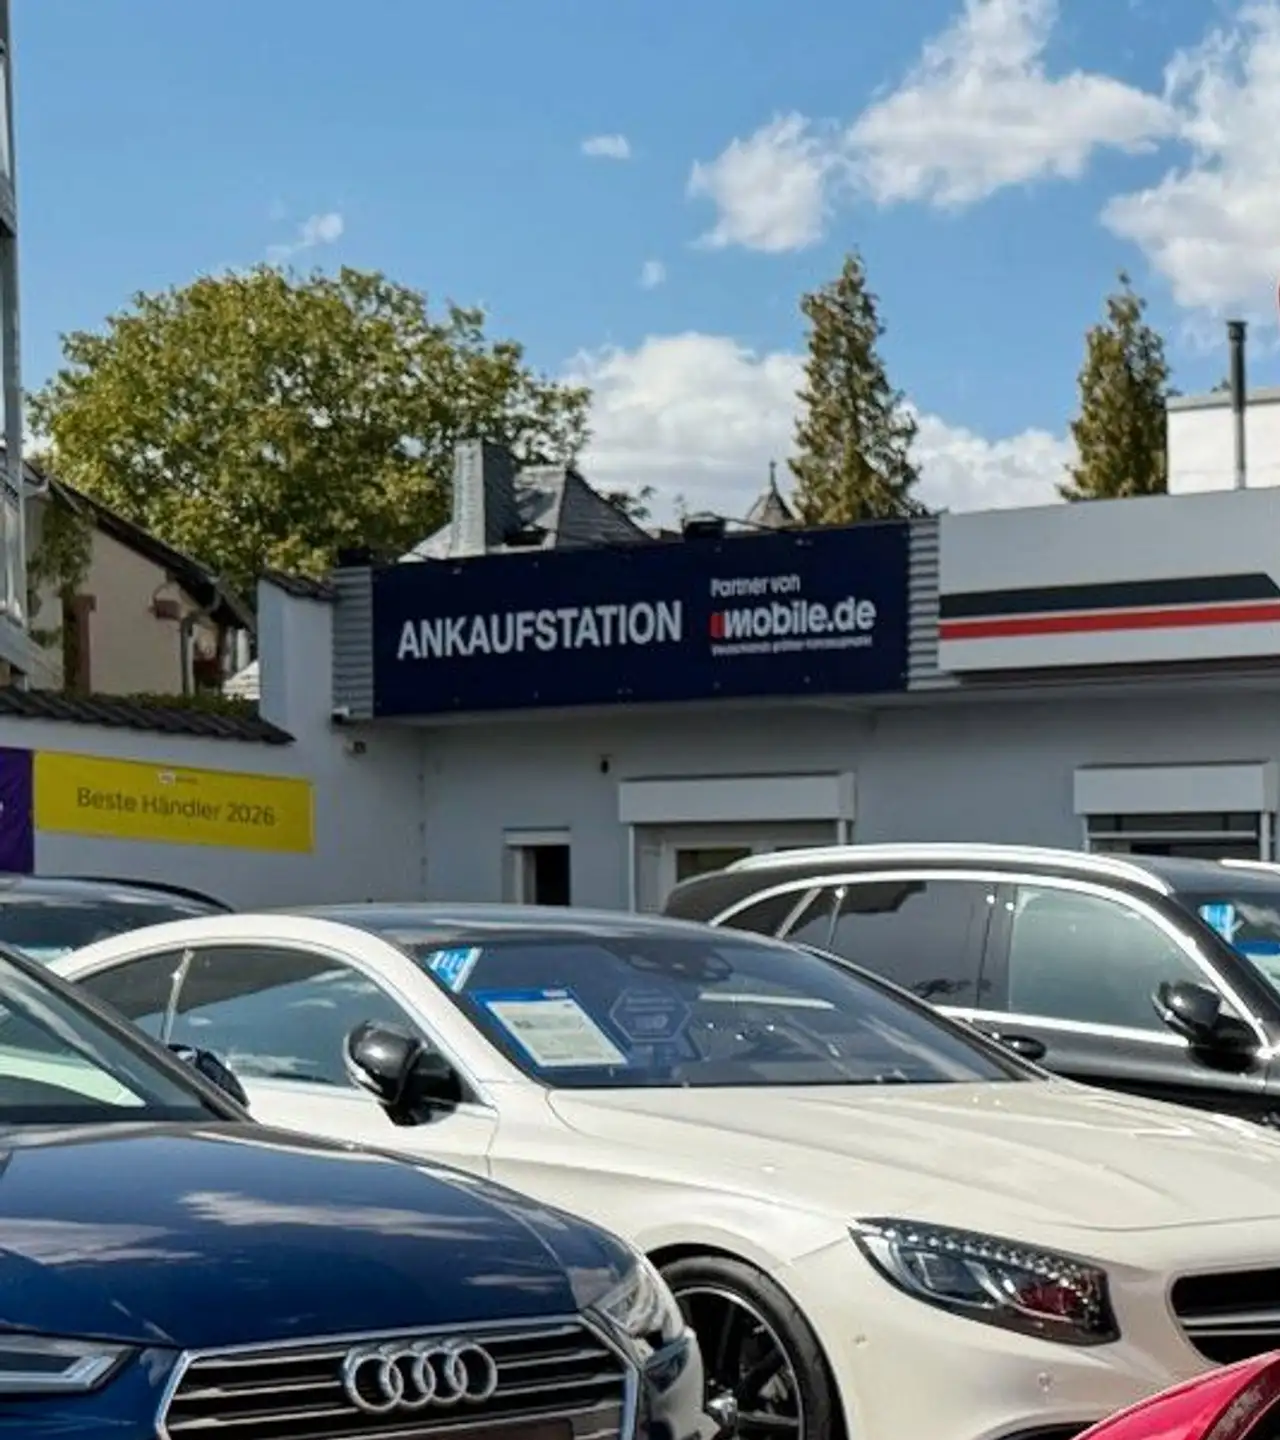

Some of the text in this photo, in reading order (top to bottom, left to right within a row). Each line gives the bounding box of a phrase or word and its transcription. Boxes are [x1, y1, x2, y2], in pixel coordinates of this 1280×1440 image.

[711, 573, 800, 597] Partner von
[398, 599, 684, 660] ANKAUFSTATION
[723, 596, 876, 639] mobile.de
[76, 786, 276, 827] Beste Händler 2026
